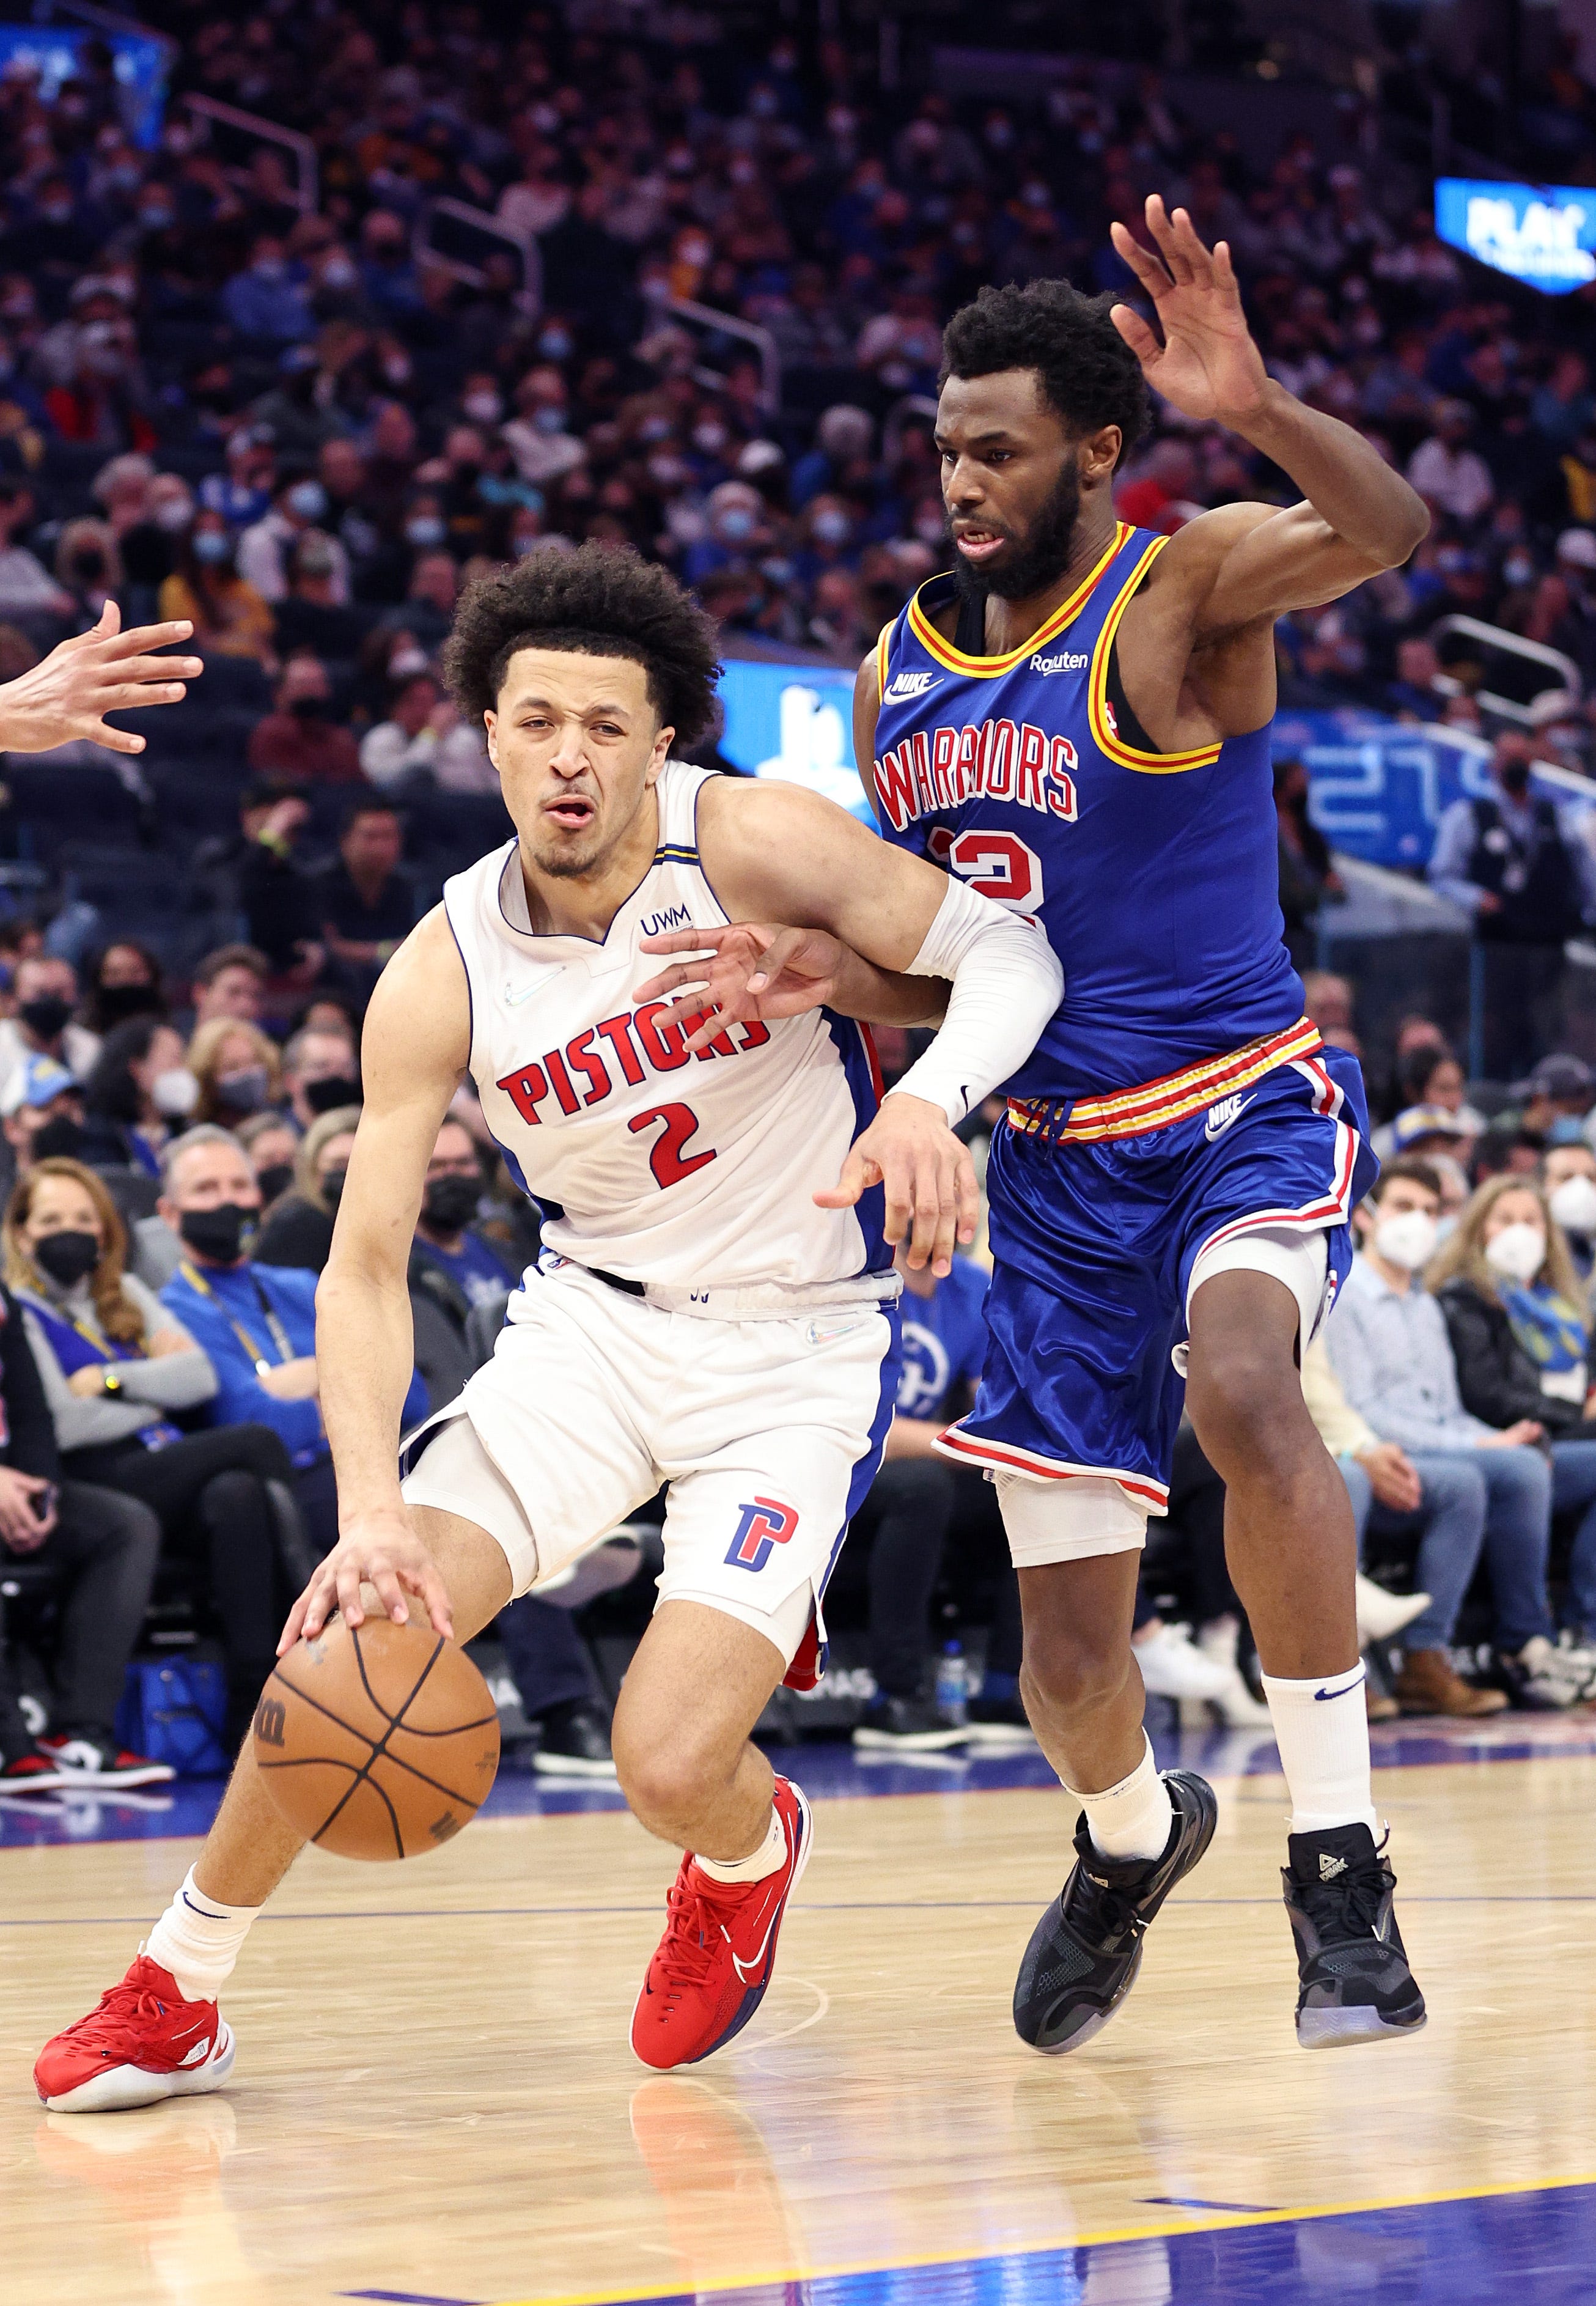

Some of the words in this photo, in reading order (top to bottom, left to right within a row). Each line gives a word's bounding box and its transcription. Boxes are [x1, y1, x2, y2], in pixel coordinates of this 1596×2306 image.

[891, 672, 933, 692] NIKE
[873, 718, 1078, 832] WARRIORS
[640, 902, 691, 936] UWM
[1208, 1093, 1242, 1129] NIKE
[627, 1102, 717, 1190] 2
